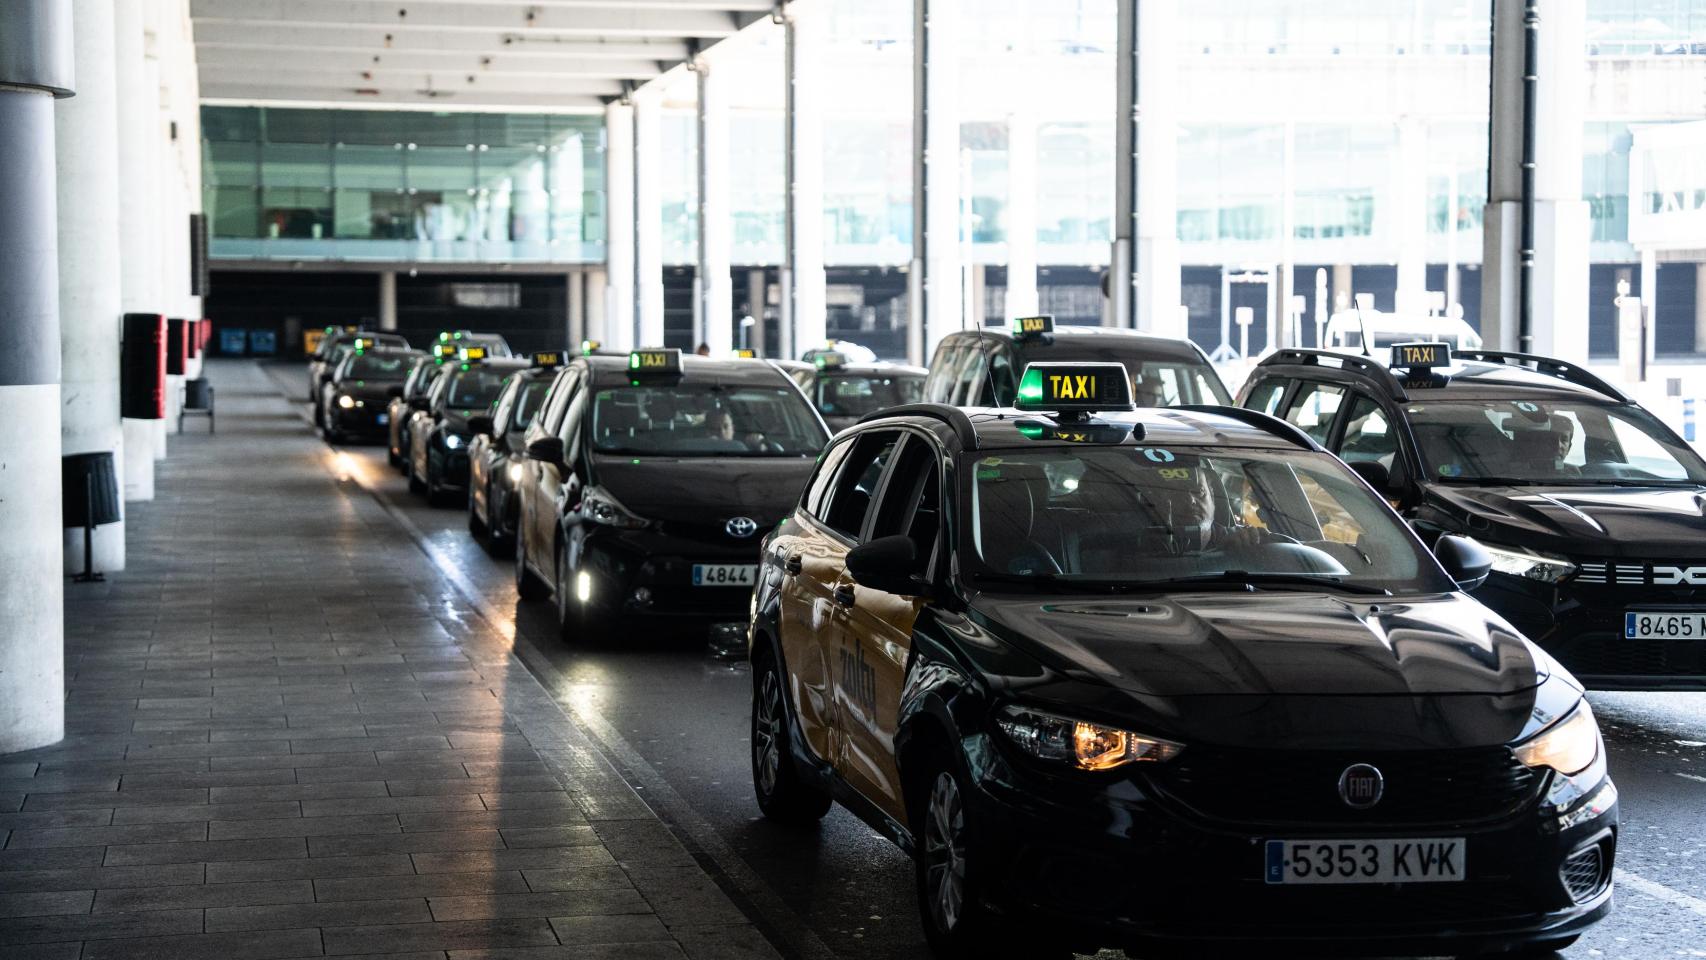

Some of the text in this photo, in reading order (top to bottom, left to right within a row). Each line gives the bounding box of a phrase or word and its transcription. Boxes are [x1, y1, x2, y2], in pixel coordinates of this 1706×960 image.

[641, 353, 666, 366] TAXI
[1404, 346, 1435, 363] TAXI
[1049, 375, 1096, 399] TAXI
[706, 568, 748, 583] 4844
[1641, 617, 1692, 636] 8465
[1349, 777, 1375, 798] FIAT
[1271, 842, 1456, 877] E 5353 KVK
